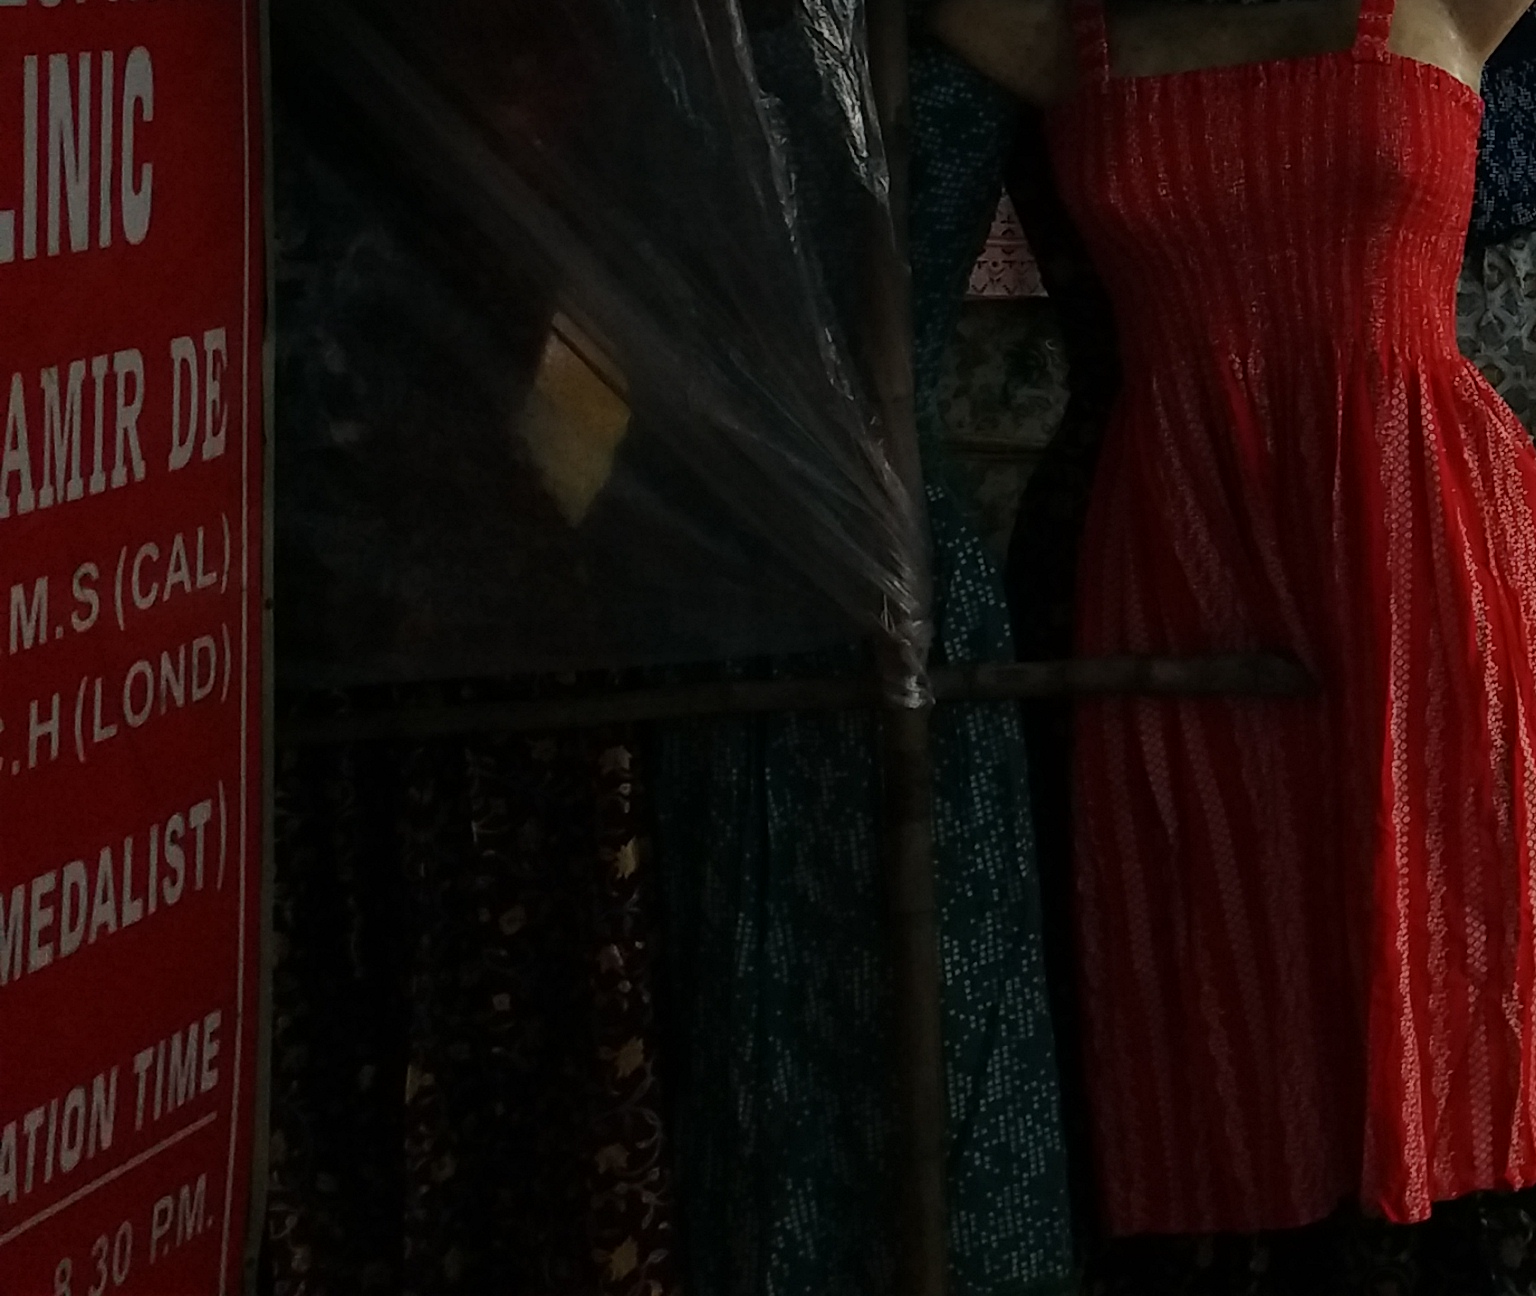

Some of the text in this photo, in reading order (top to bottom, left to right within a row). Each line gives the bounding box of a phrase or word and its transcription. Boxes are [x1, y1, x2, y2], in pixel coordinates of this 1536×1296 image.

[0, 326, 228, 519] AMIR DE
[133, 1008, 222, 1132] TIME
